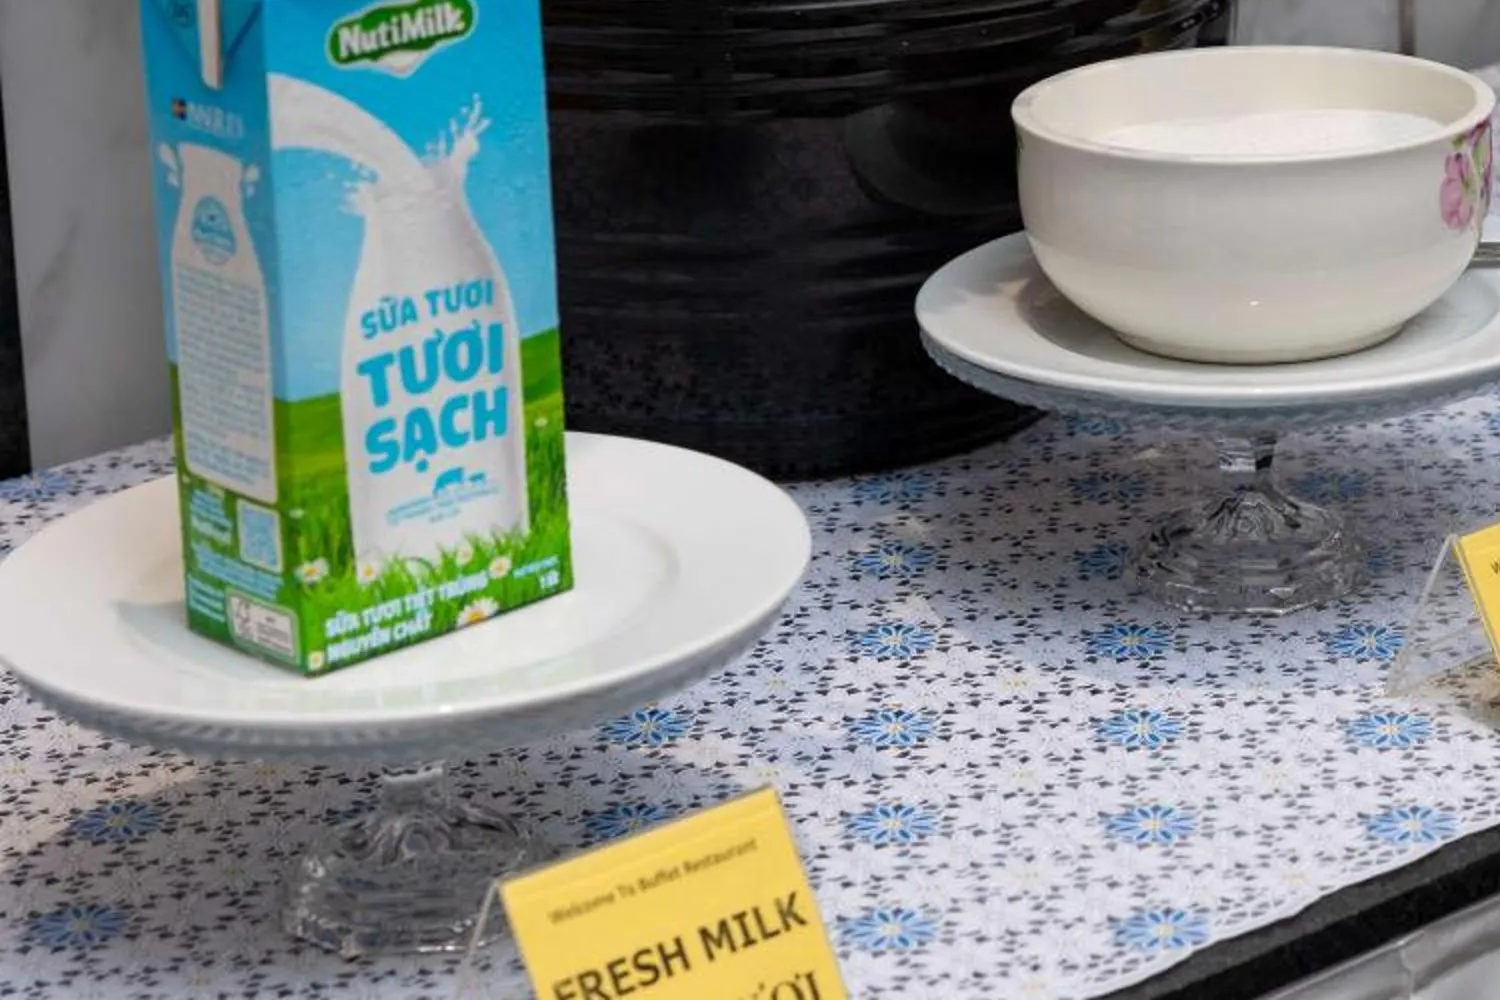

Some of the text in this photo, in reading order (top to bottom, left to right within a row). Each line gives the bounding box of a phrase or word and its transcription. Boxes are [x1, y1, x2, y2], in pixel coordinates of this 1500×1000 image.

[338, 1, 464, 60] NutiMilk
[356, 318, 505, 408] TƯƠI
[365, 386, 509, 474] SẠCH
[548, 838, 758, 925] Welcome To Buffet Restaurant
[552, 891, 808, 1000] FRESH MILK
